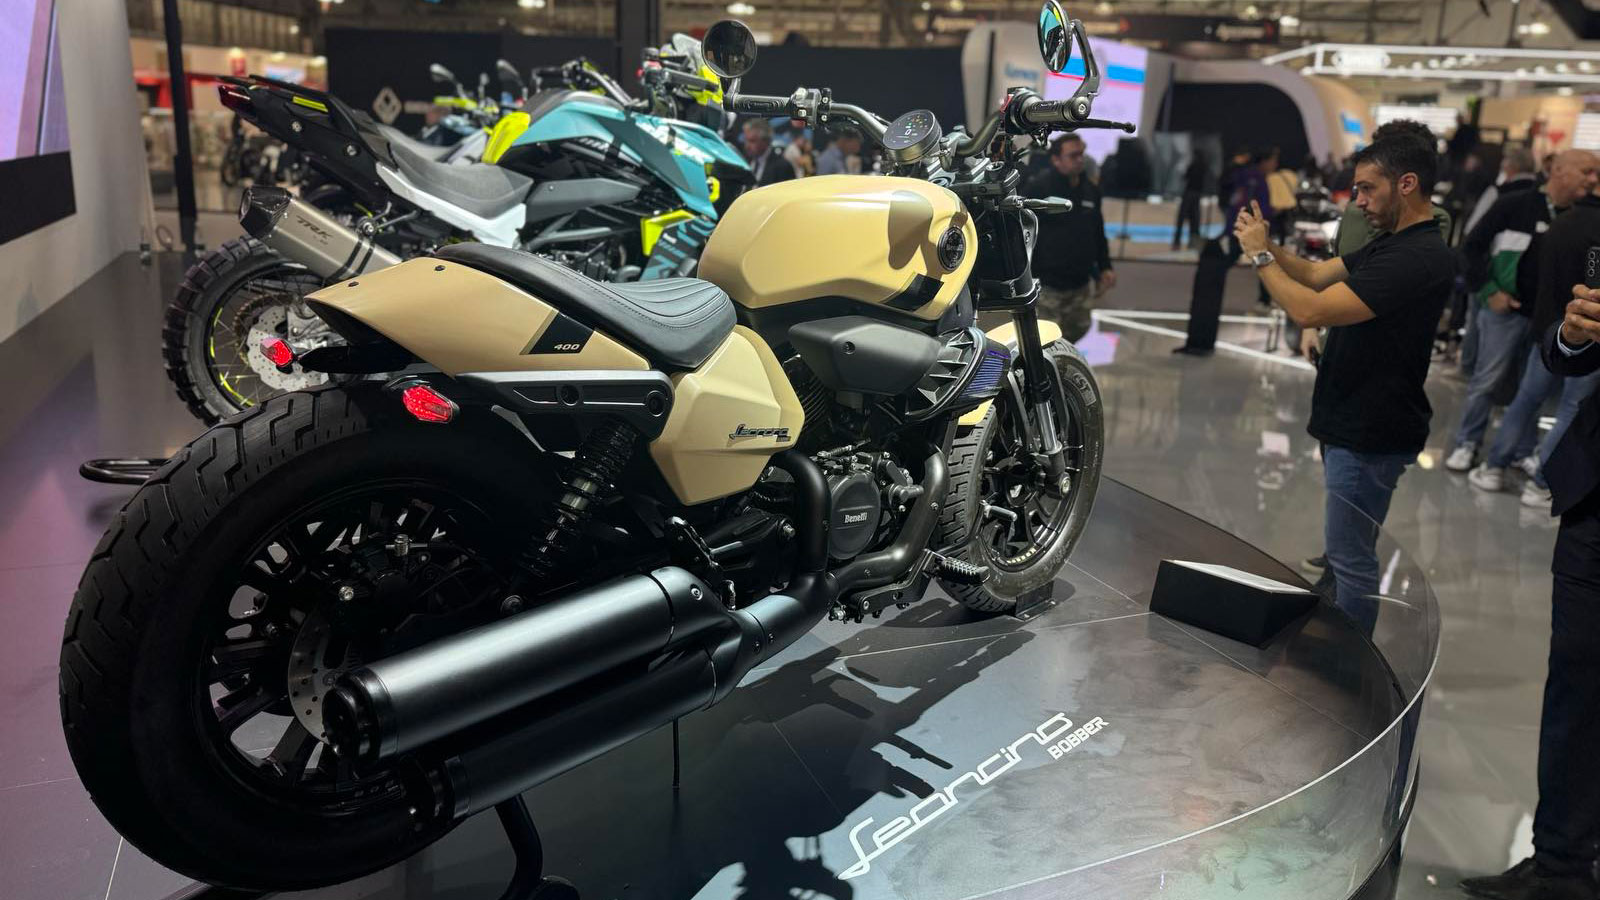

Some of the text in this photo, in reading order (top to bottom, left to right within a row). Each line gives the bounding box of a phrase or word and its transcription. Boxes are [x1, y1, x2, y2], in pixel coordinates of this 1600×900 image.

[296, 214, 332, 237] TRK
[844, 512, 868, 523] Benelli
[1047, 716, 1110, 760] BOBBER
